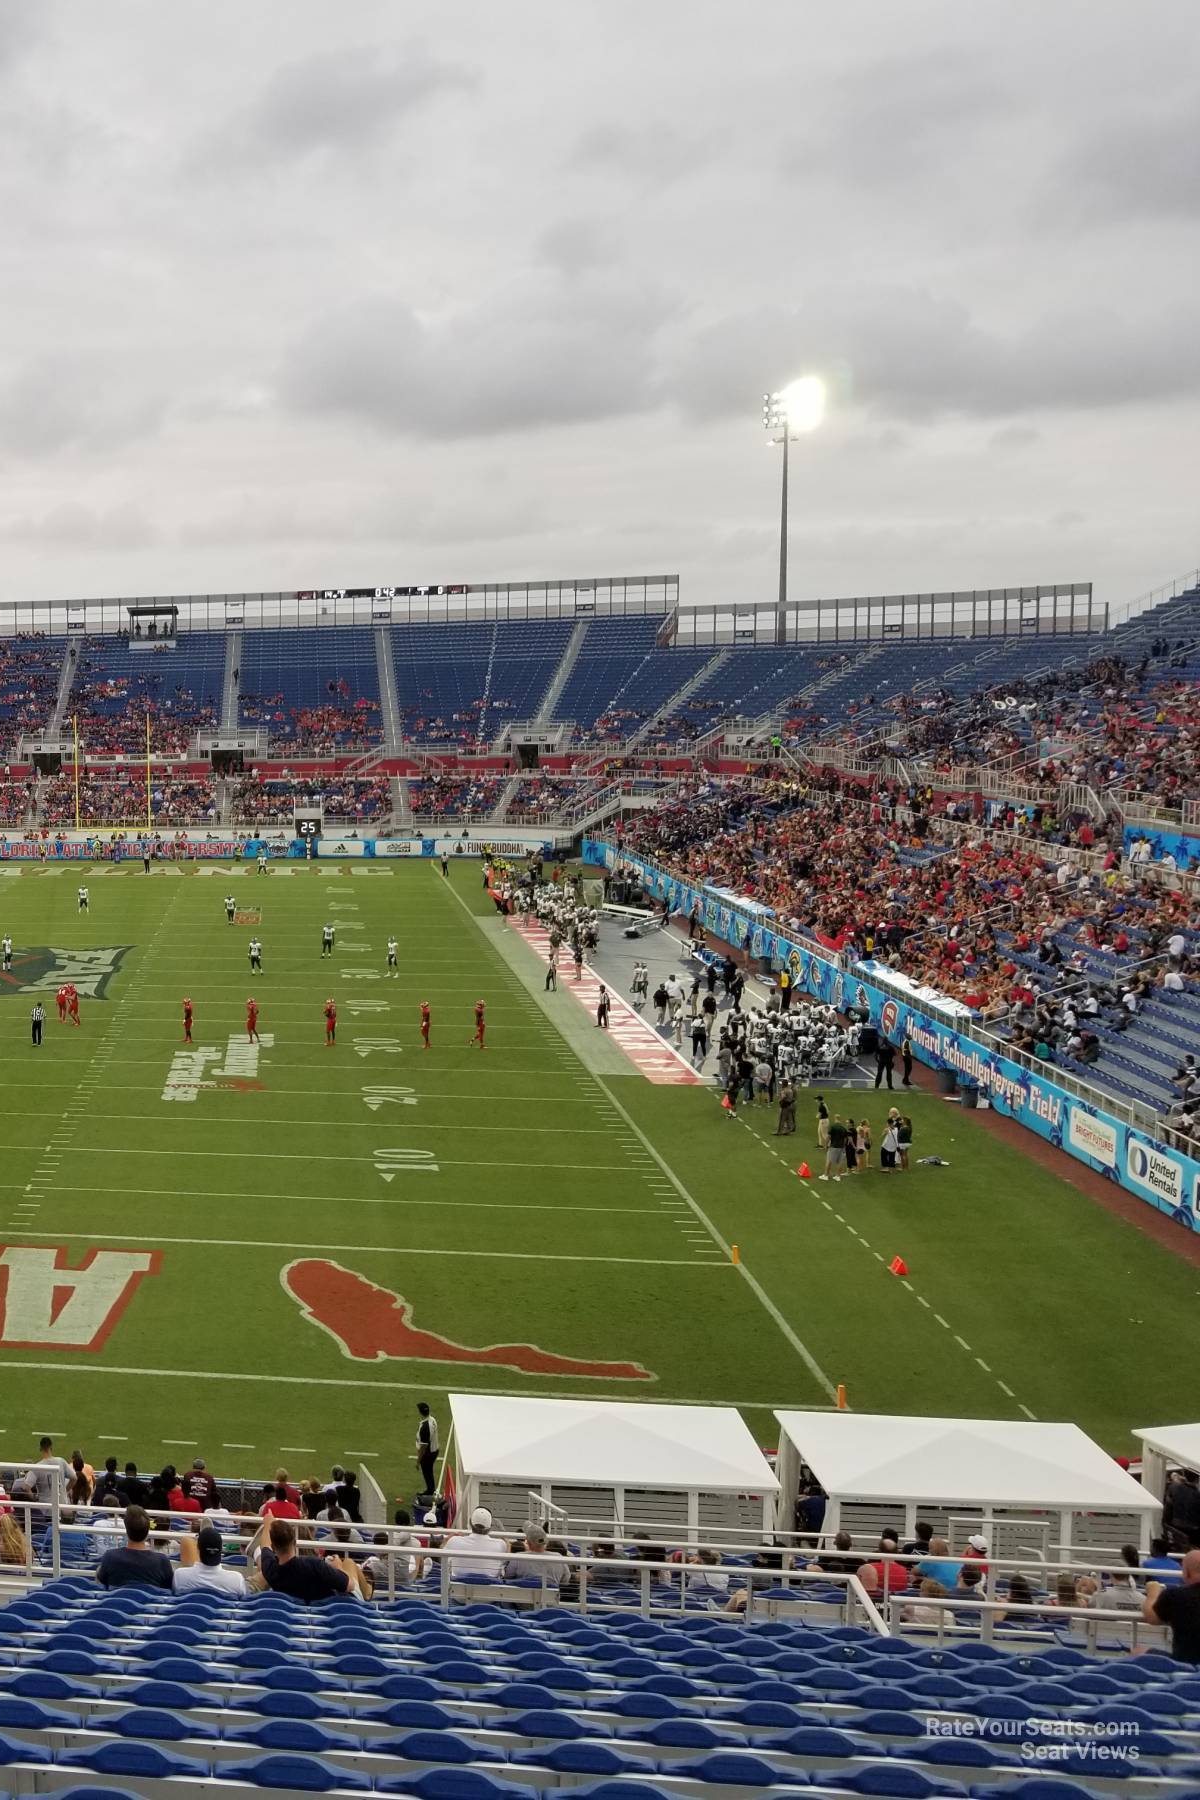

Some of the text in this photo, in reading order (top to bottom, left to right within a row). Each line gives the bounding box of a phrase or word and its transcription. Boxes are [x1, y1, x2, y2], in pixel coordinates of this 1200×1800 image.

[301, 822, 315, 833] 25
[906, 1015, 942, 1056] Howard
[943, 1033, 1027, 1106] Schnellenberger
[1029, 1084, 1061, 1126] Field
[360, 1085, 418, 1105] 20
[372, 1148, 441, 1172] 10
[1149, 1155, 1177, 1181] United
[1148, 1170, 1178, 1198] Rentals
